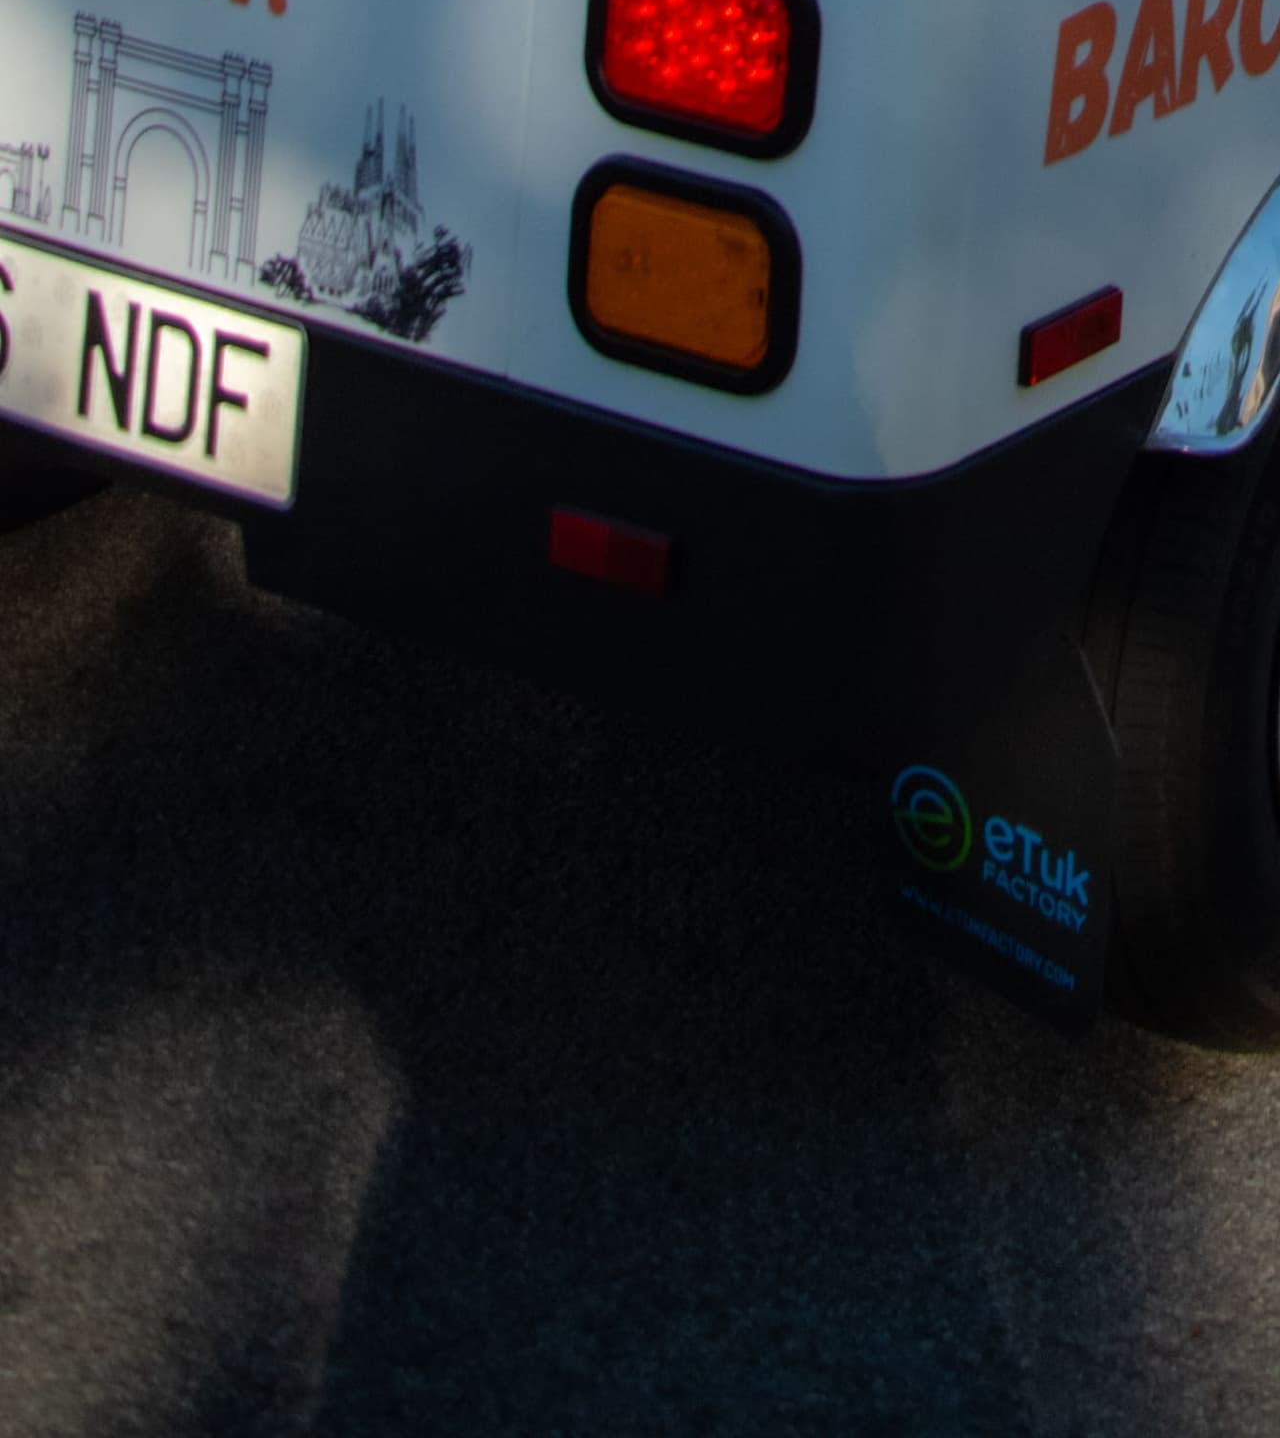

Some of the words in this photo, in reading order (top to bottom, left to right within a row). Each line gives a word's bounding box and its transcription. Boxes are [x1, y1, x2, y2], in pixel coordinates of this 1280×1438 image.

[77, 289, 270, 458] NDF
[982, 859, 1087, 935] FACTORY
[984, 815, 1091, 907] eTuk
